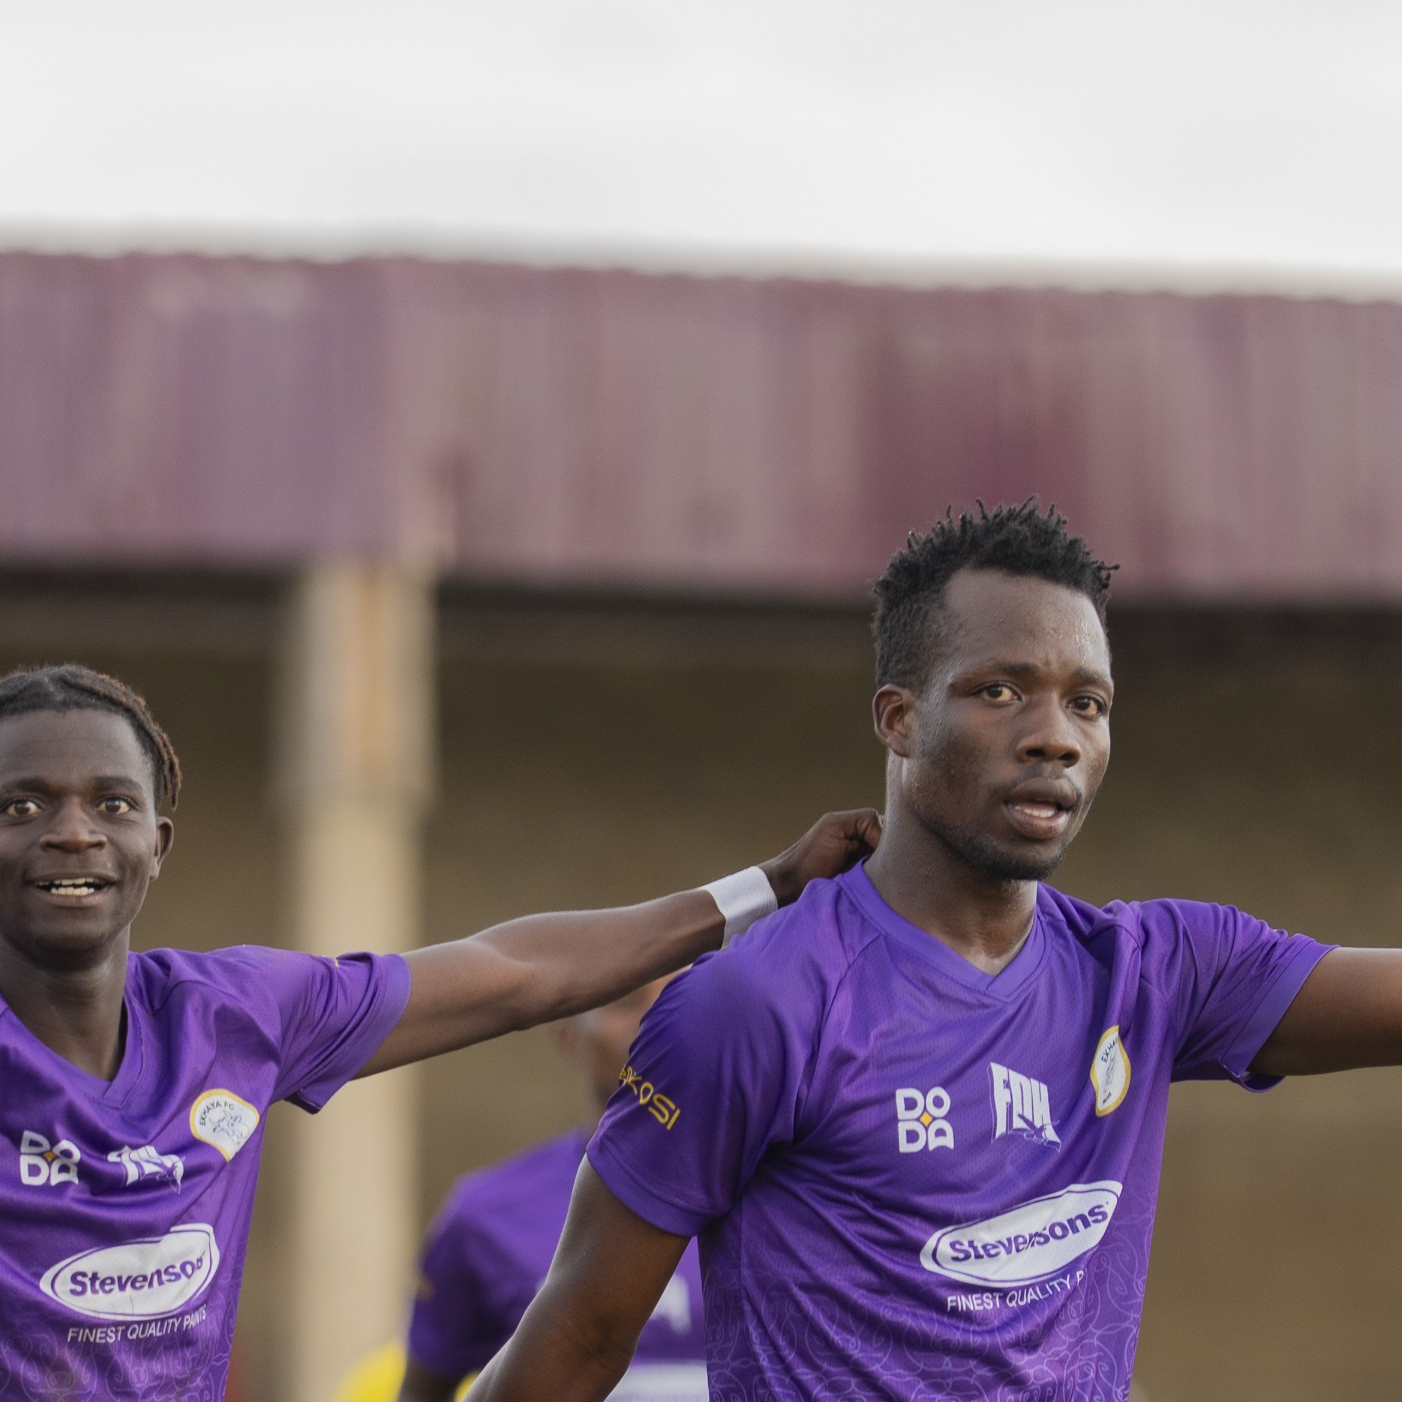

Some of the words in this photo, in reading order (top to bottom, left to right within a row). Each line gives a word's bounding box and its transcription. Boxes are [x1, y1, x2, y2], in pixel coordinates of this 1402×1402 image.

[947, 1292, 1003, 1312] FINEST
[1006, 1274, 1071, 1308] QUALITY
[67, 1326, 125, 1344] FINEST
[127, 1317, 181, 1340] QUALITY
